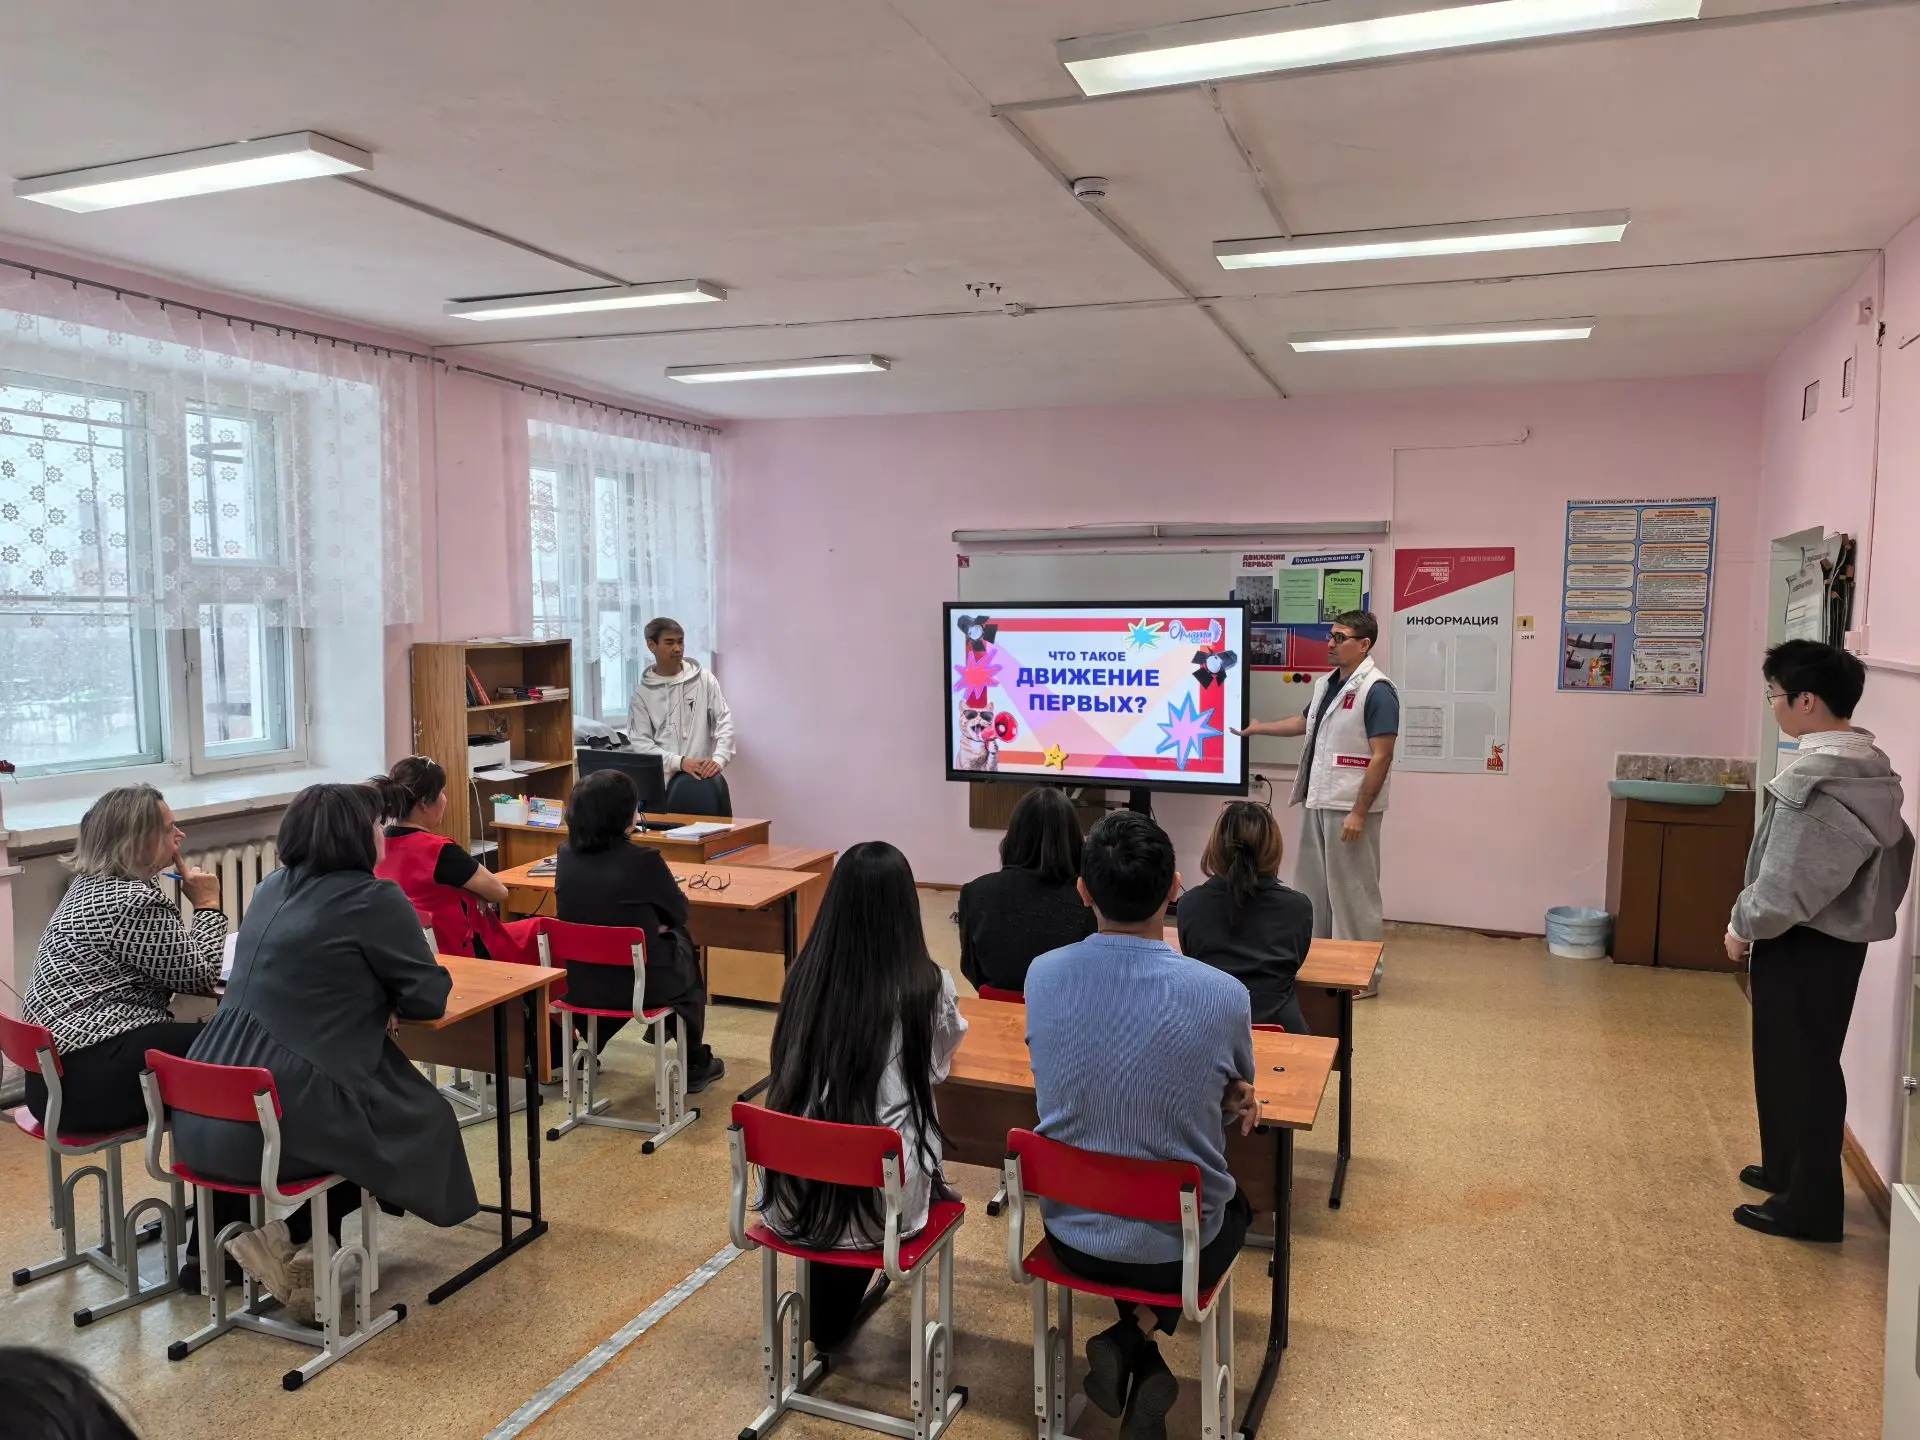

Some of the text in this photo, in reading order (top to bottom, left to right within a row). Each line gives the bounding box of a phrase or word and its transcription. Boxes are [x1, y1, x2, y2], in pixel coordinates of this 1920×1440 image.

[1406, 616, 1499, 627] ИНФОРМАЦИЯ
[1048, 651, 1126, 662] ЧТО ТАКОЕ
[1016, 667, 1160, 688] ДВИЖЕНИЕ
[1029, 694, 1148, 714] ПЕРВЫХ?
